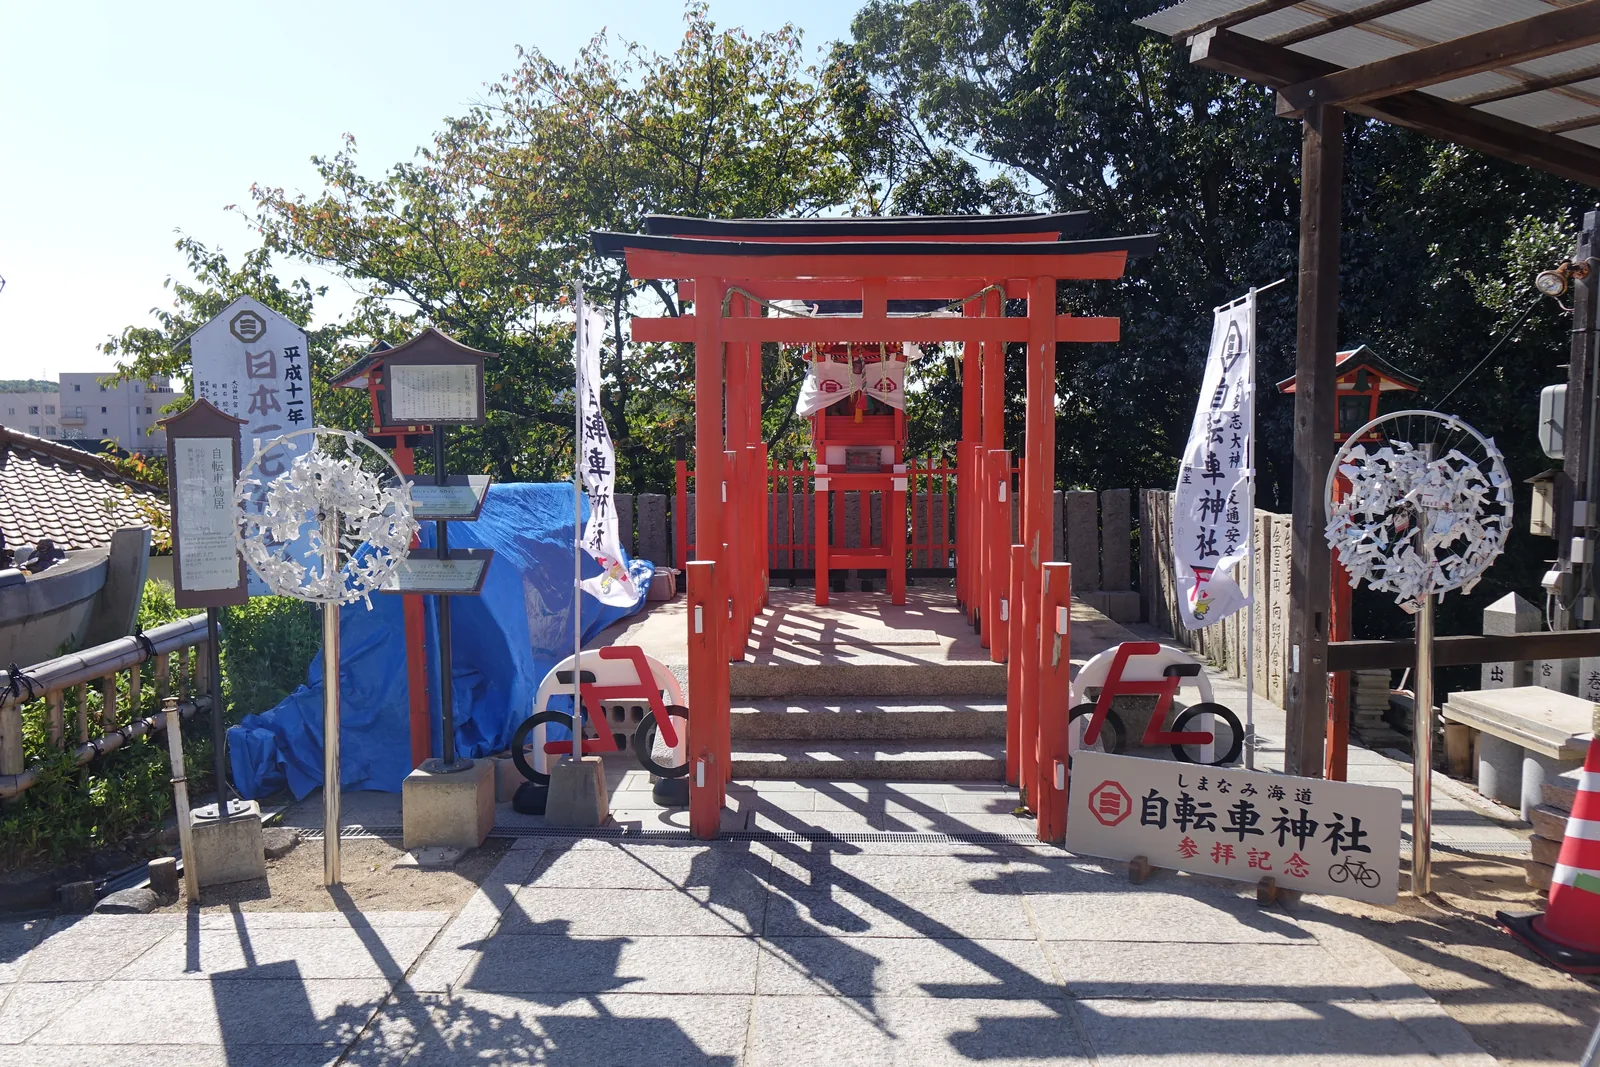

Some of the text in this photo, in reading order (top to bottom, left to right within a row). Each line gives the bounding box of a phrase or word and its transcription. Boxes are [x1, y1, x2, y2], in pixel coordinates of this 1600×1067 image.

[283, 345, 305, 425] 平成十一年
[211, 447, 225, 510] 自転車鳥居
[1194, 376, 1229, 561] 自転車神社
[1139, 787, 1372, 857] 自転車神社
[1178, 773, 1314, 805] しまなみ海道
[1175, 835, 1311, 879] 参拝記念
